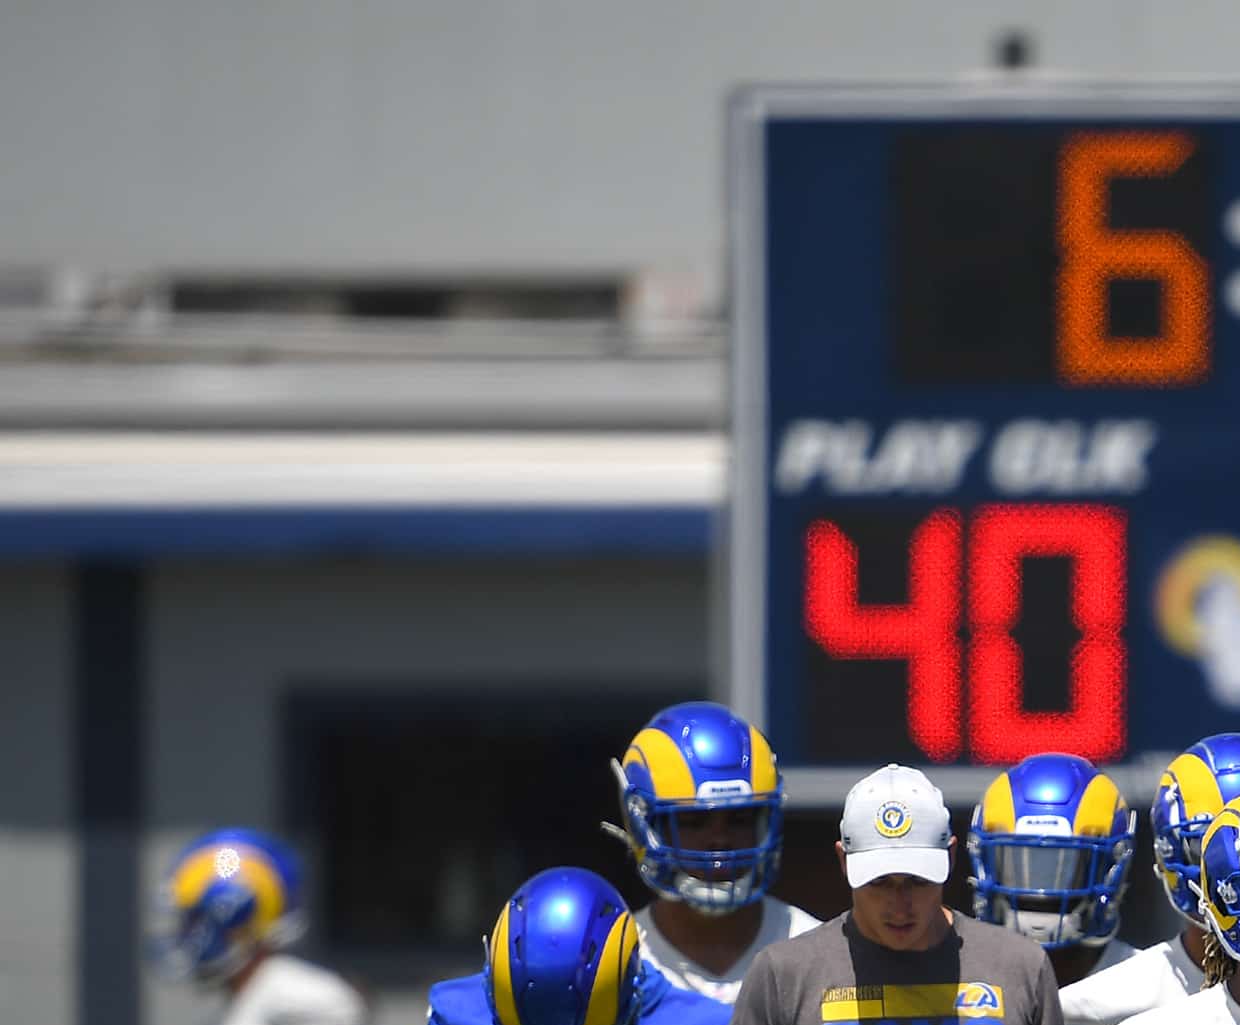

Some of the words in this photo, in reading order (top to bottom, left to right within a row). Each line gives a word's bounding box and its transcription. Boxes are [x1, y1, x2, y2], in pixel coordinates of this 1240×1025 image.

[775, 418, 982, 494] PLAY
[988, 418, 1156, 494] CLK
[805, 506, 1128, 763] 40
